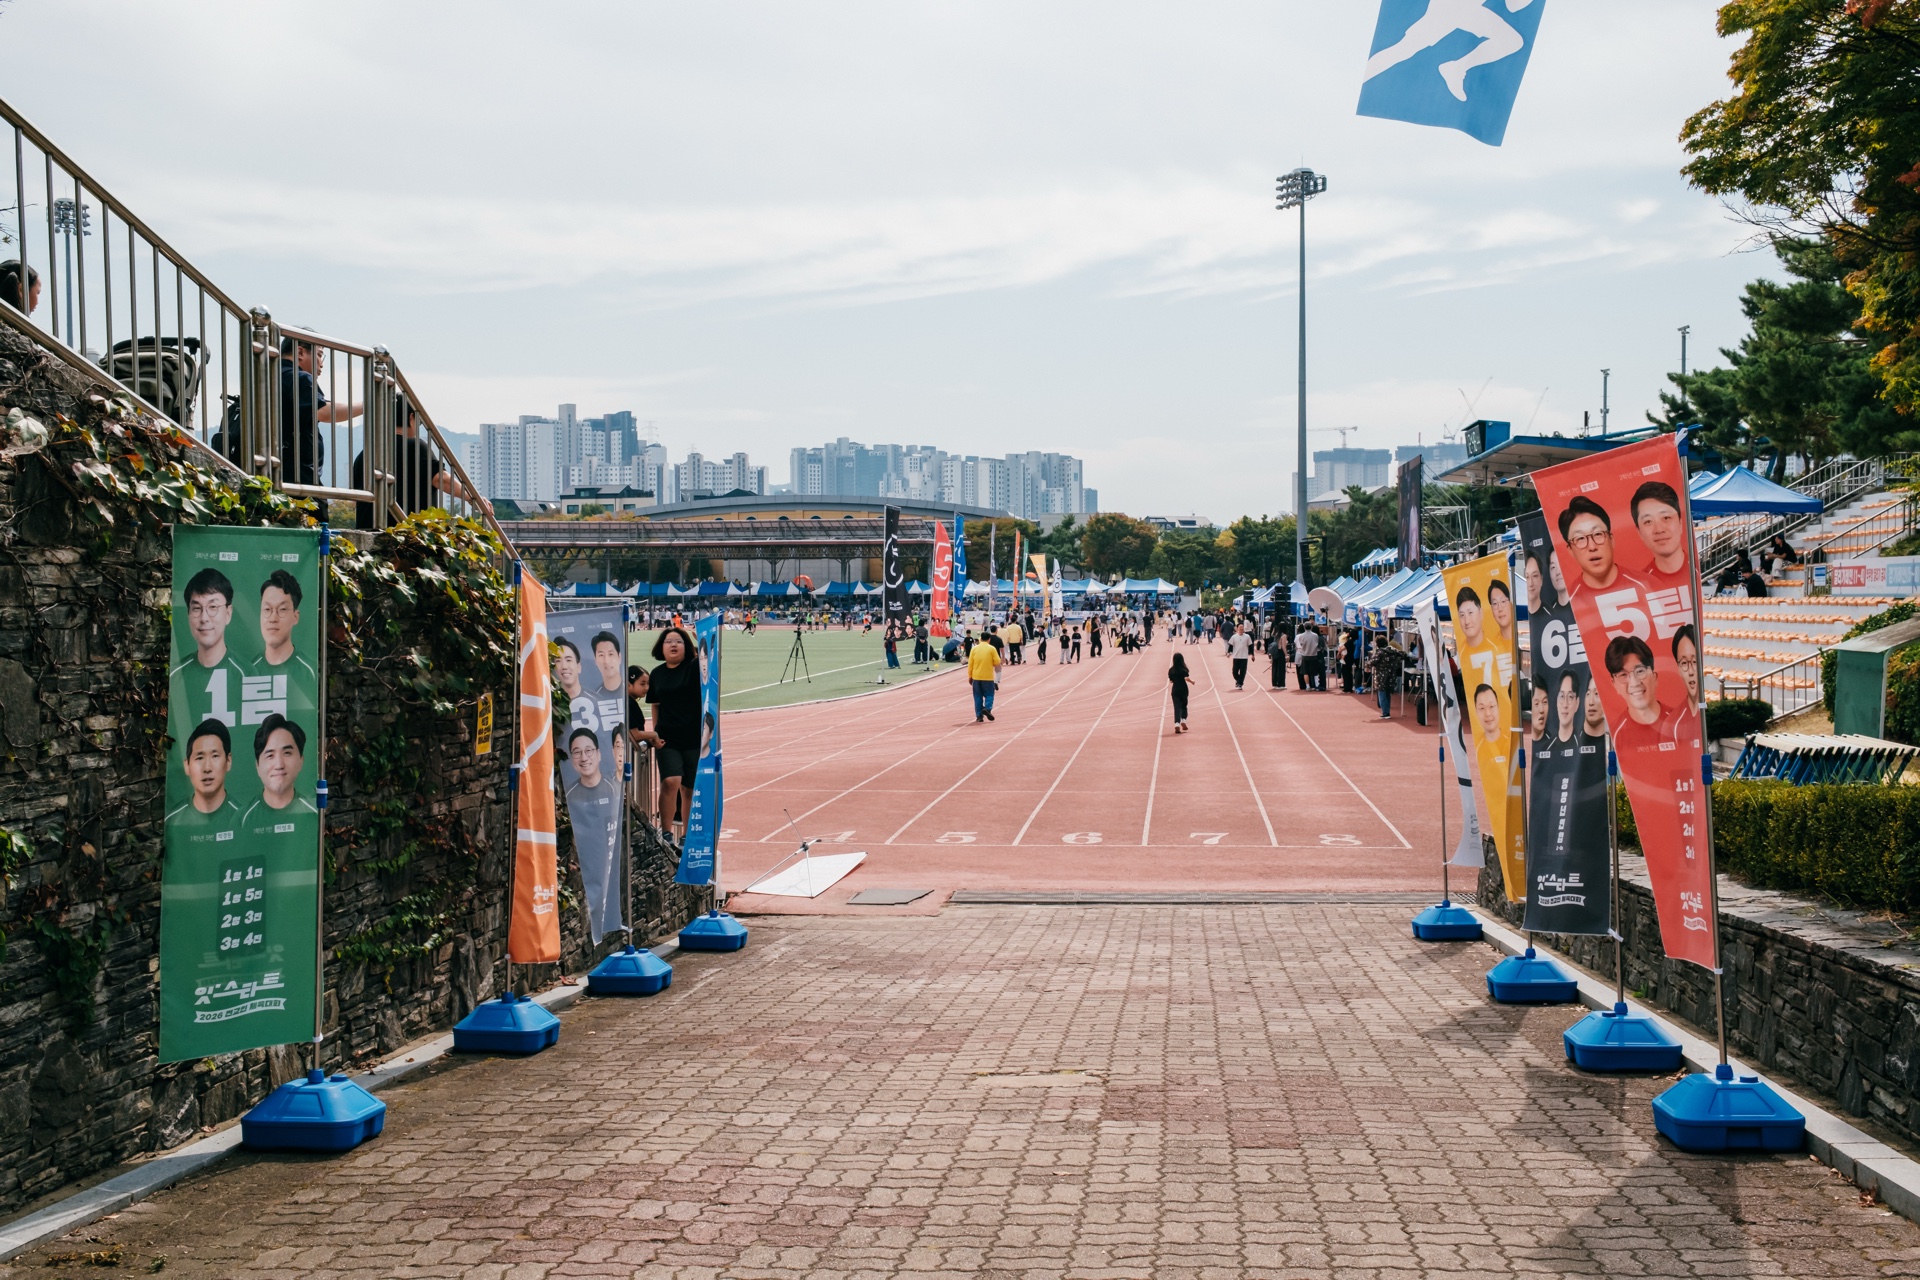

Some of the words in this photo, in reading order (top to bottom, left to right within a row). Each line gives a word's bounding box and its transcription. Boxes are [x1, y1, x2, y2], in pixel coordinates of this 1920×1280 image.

[1594, 584, 1694, 642] 5팀
[202, 668, 288, 728] 1팀
[569, 696, 624, 733] 3팀
[935, 832, 978, 844] 5
[1062, 832, 1103, 844] 6
[1190, 832, 1230, 844] 7
[1318, 834, 1362, 846] 8
[200, 1012, 223, 1020] 2026
[225, 1005, 248, 1018] 전교인
[249, 1000, 281, 1010] 체육대회
